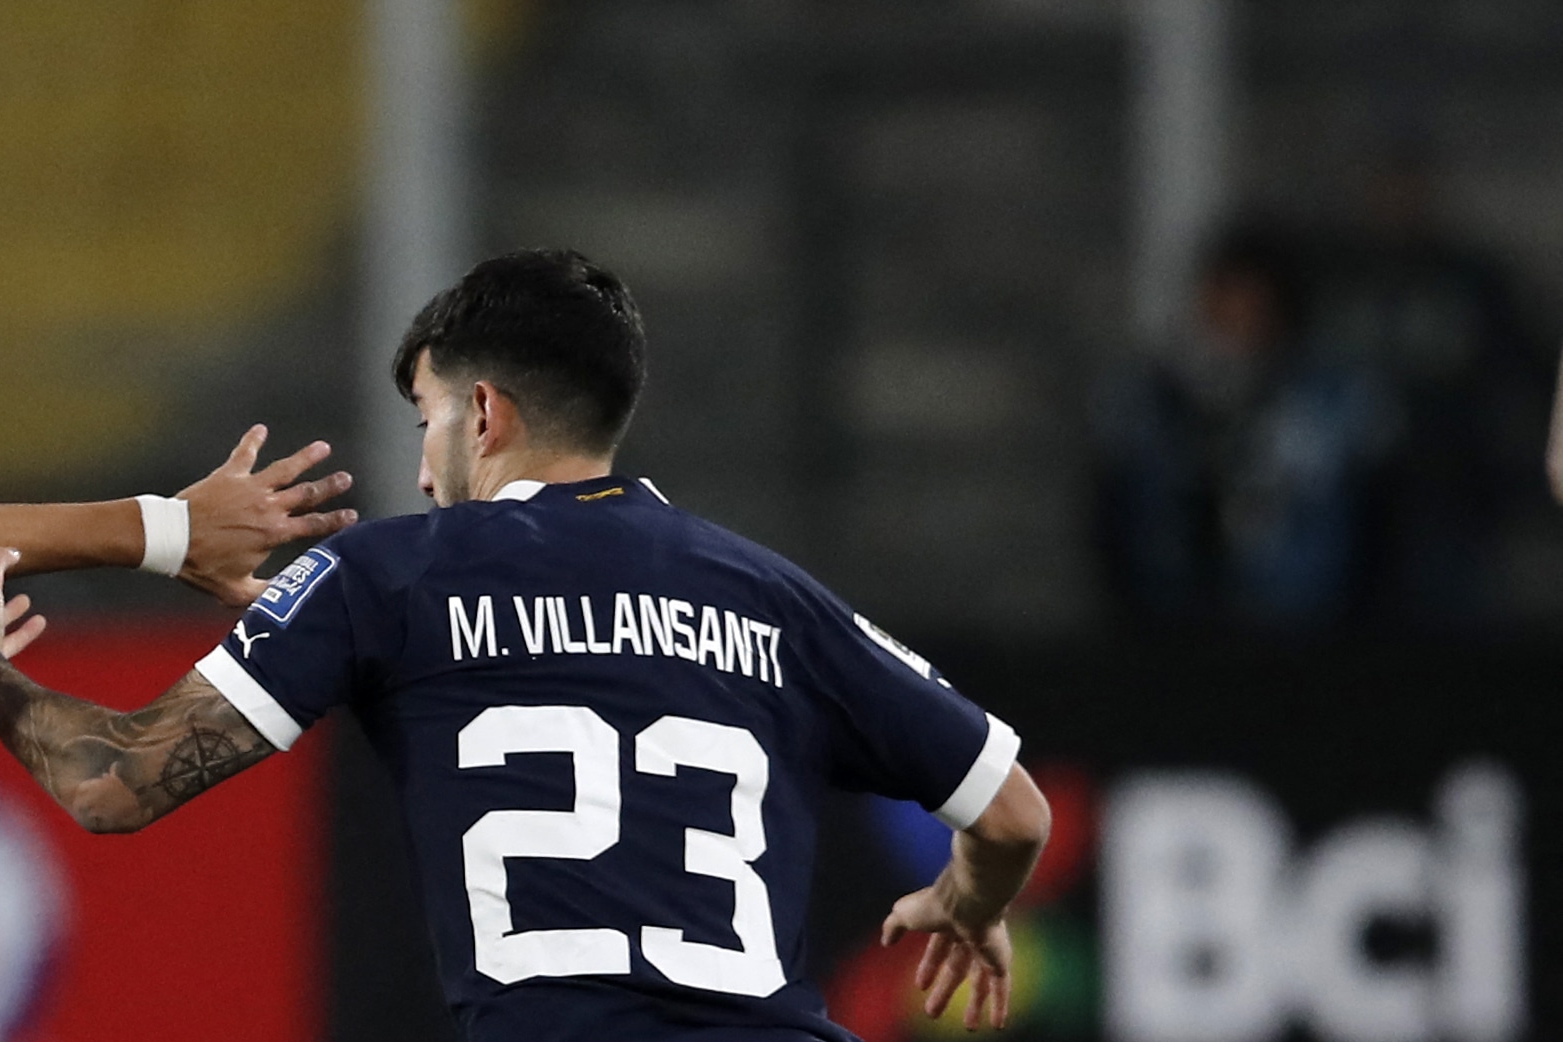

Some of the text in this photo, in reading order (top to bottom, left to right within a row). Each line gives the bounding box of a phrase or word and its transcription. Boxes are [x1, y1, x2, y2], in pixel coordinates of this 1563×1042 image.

[447, 592, 784, 689] M. VILLANSANTI
[457, 704, 789, 999] 23
